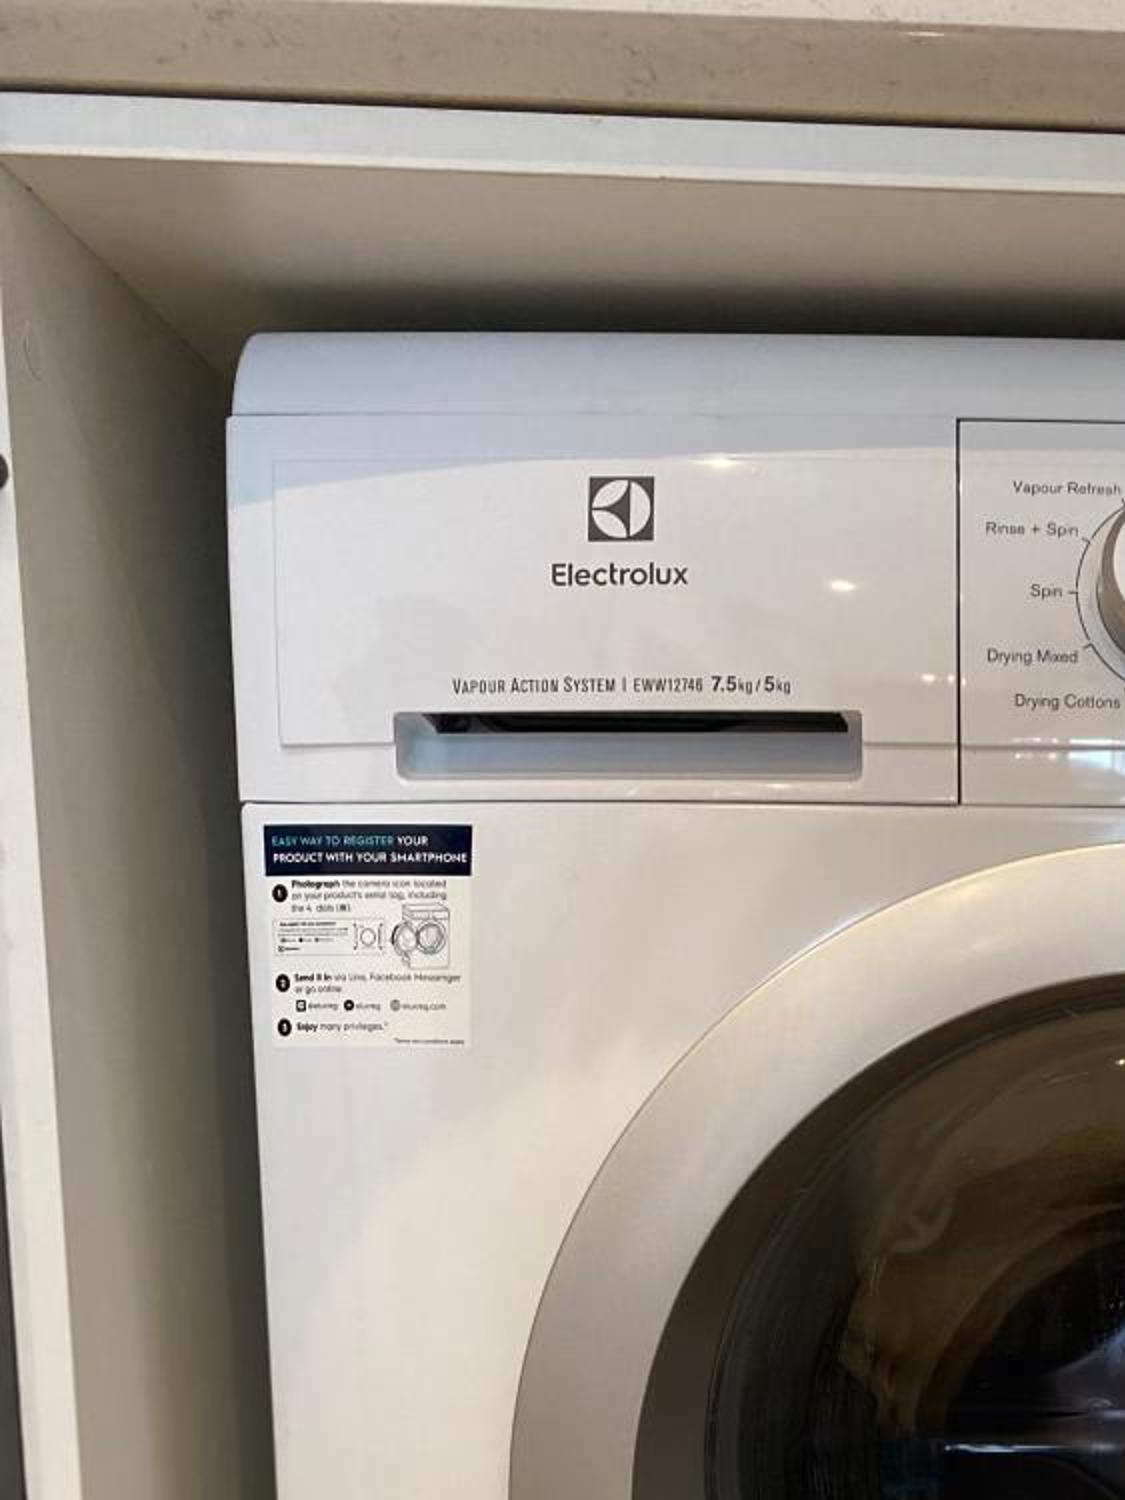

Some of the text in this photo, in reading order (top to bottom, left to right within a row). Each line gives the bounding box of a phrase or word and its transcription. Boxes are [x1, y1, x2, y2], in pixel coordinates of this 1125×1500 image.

[1013, 480, 1122, 496] Vapour Refresh
[985, 521, 1025, 535] Rinse
[1046, 522, 1079, 538] Spin
[551, 562, 688, 586] Electrolux
[1030, 583, 1063, 599] Spin
[987, 648, 1079, 666] Drying Mixed
[633, 677, 703, 692] EWW12746
[1015, 693, 1121, 710] Drying Cottons
[271, 835, 429, 847] EASY WAY TO REGISTER YOUR
[273, 852, 468, 864] PRODUCT WITH YOUR SMARTPHONE
[291, 879, 341, 890] Photograph
[294, 973, 315, 982] Send
[370, 973, 412, 982] Facebook
[297, 1022, 318, 1033] Enjoy
